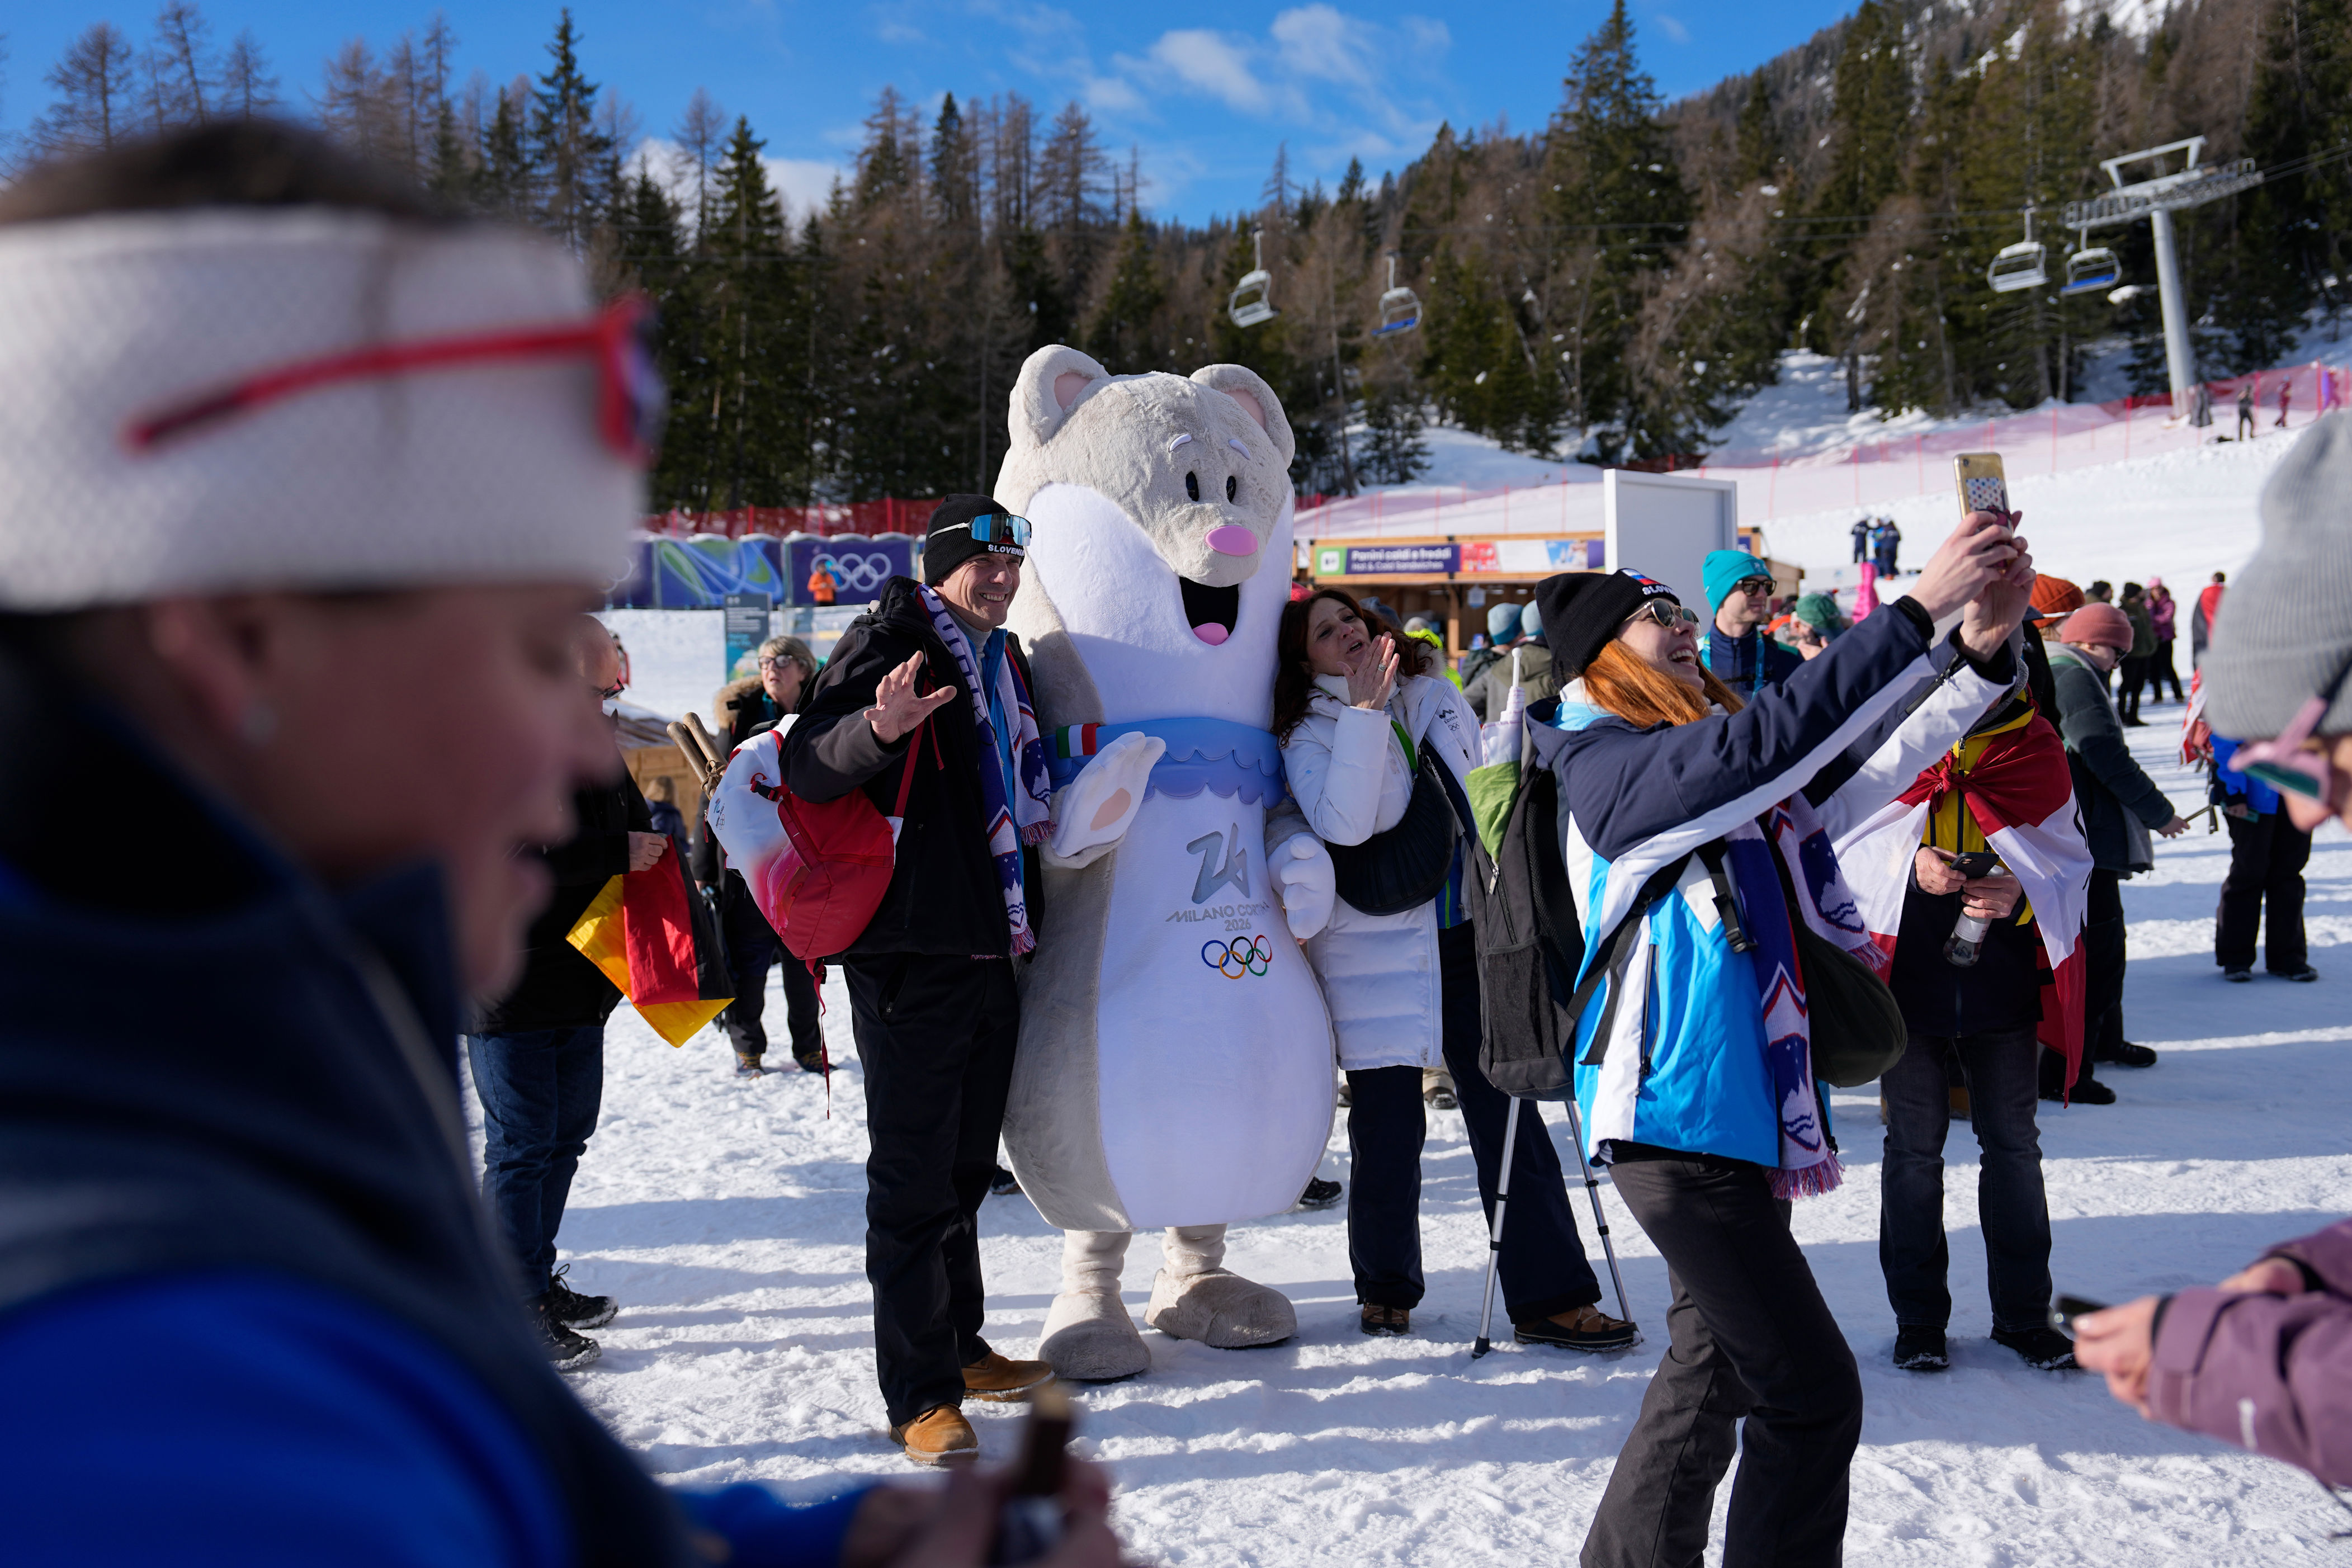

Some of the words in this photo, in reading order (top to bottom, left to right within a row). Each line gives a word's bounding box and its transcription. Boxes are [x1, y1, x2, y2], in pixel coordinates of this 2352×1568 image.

[1351, 549, 1385, 561] Panini
[1385, 548, 1411, 560] caldi
[1419, 547, 1452, 560] freddi
[1165, 905, 1235, 923] MILANO
[1224, 918, 1252, 932] 2026
